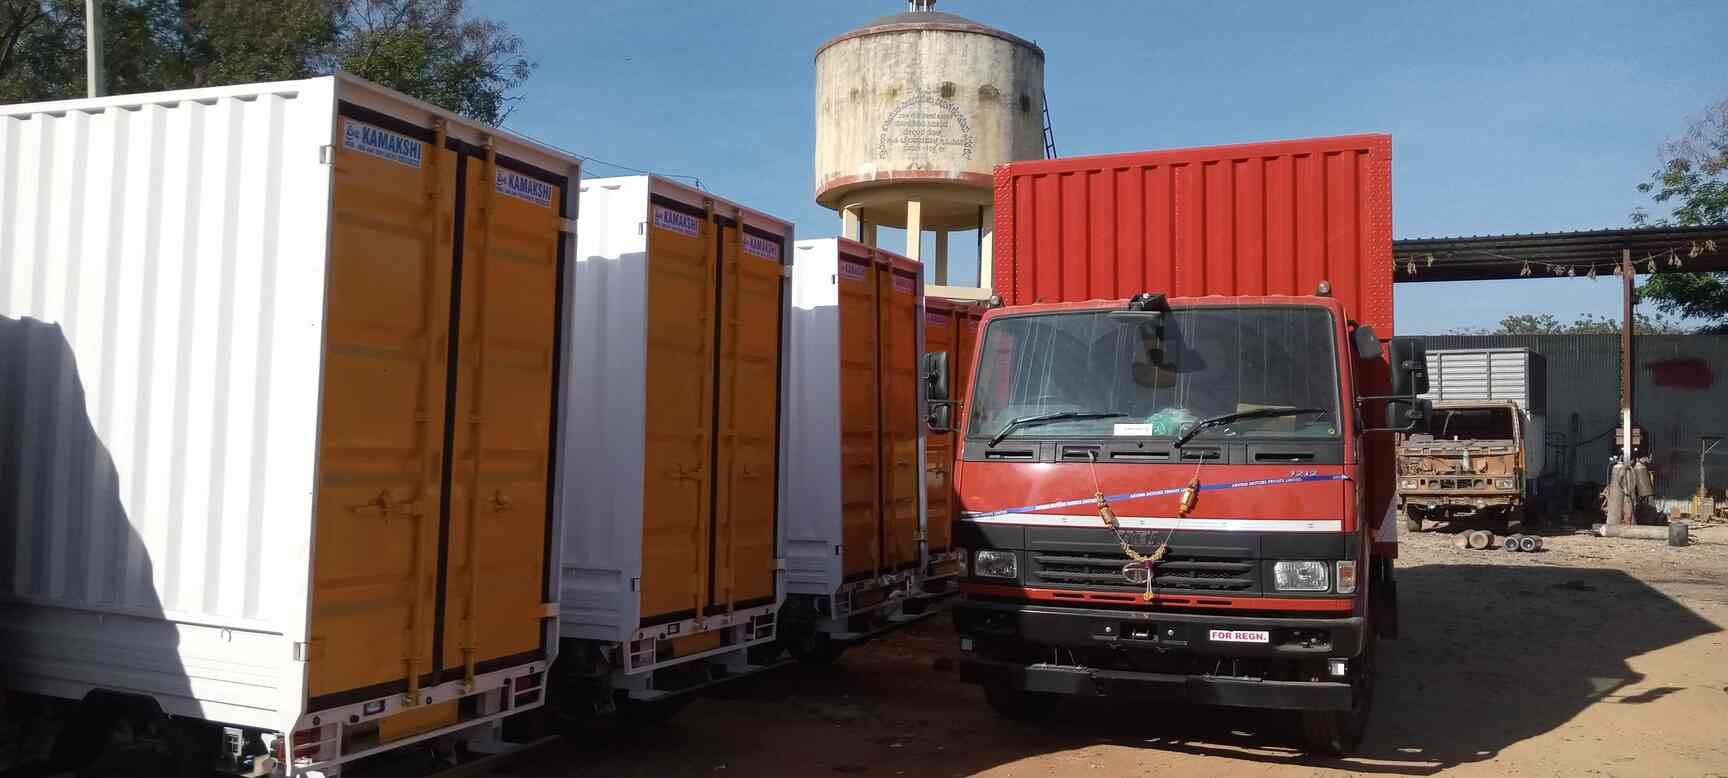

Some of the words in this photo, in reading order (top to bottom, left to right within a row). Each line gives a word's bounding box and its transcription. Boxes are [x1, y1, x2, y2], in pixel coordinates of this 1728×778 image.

[362, 126, 421, 159] KAMAKSHI
[509, 175, 551, 200] KAMAKSHI
[1212, 631, 1232, 640] FOR
[1235, 632, 1267, 641] REGN.
